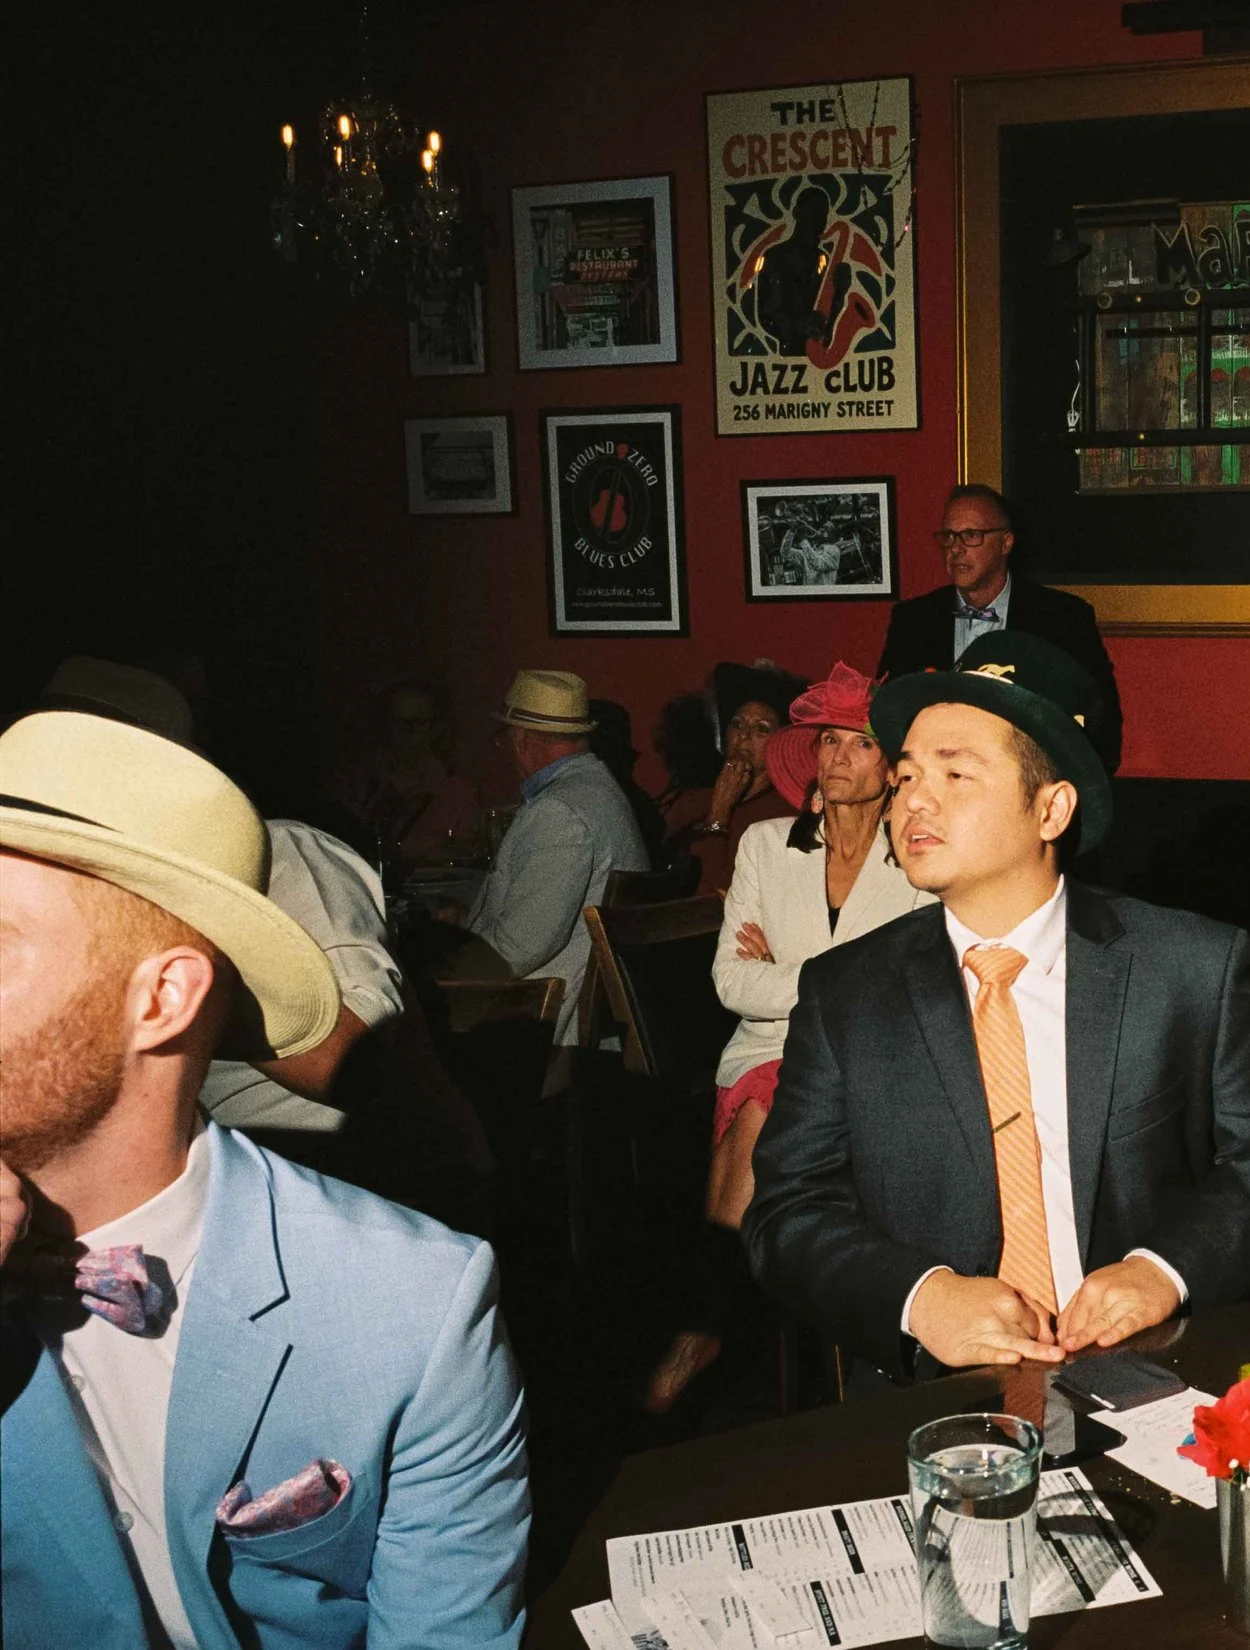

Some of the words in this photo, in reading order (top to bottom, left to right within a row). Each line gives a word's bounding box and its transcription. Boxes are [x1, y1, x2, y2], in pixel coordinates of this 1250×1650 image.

[770, 99, 836, 126] THE
[722, 124, 897, 180] CRESCENT
[577, 247, 631, 260] FELIX'S
[729, 361, 809, 397] JAZZ
[733, 405, 760, 421] 256
[765, 402, 831, 420] MARIGNY
[836, 400, 894, 418] STREET
[565, 440, 615, 484] GROUND
[627, 448, 659, 487] ZERO
[574, 537, 615, 569] BLUES
[619, 536, 653, 568] CLUB
[636, 587, 657, 597] MS
